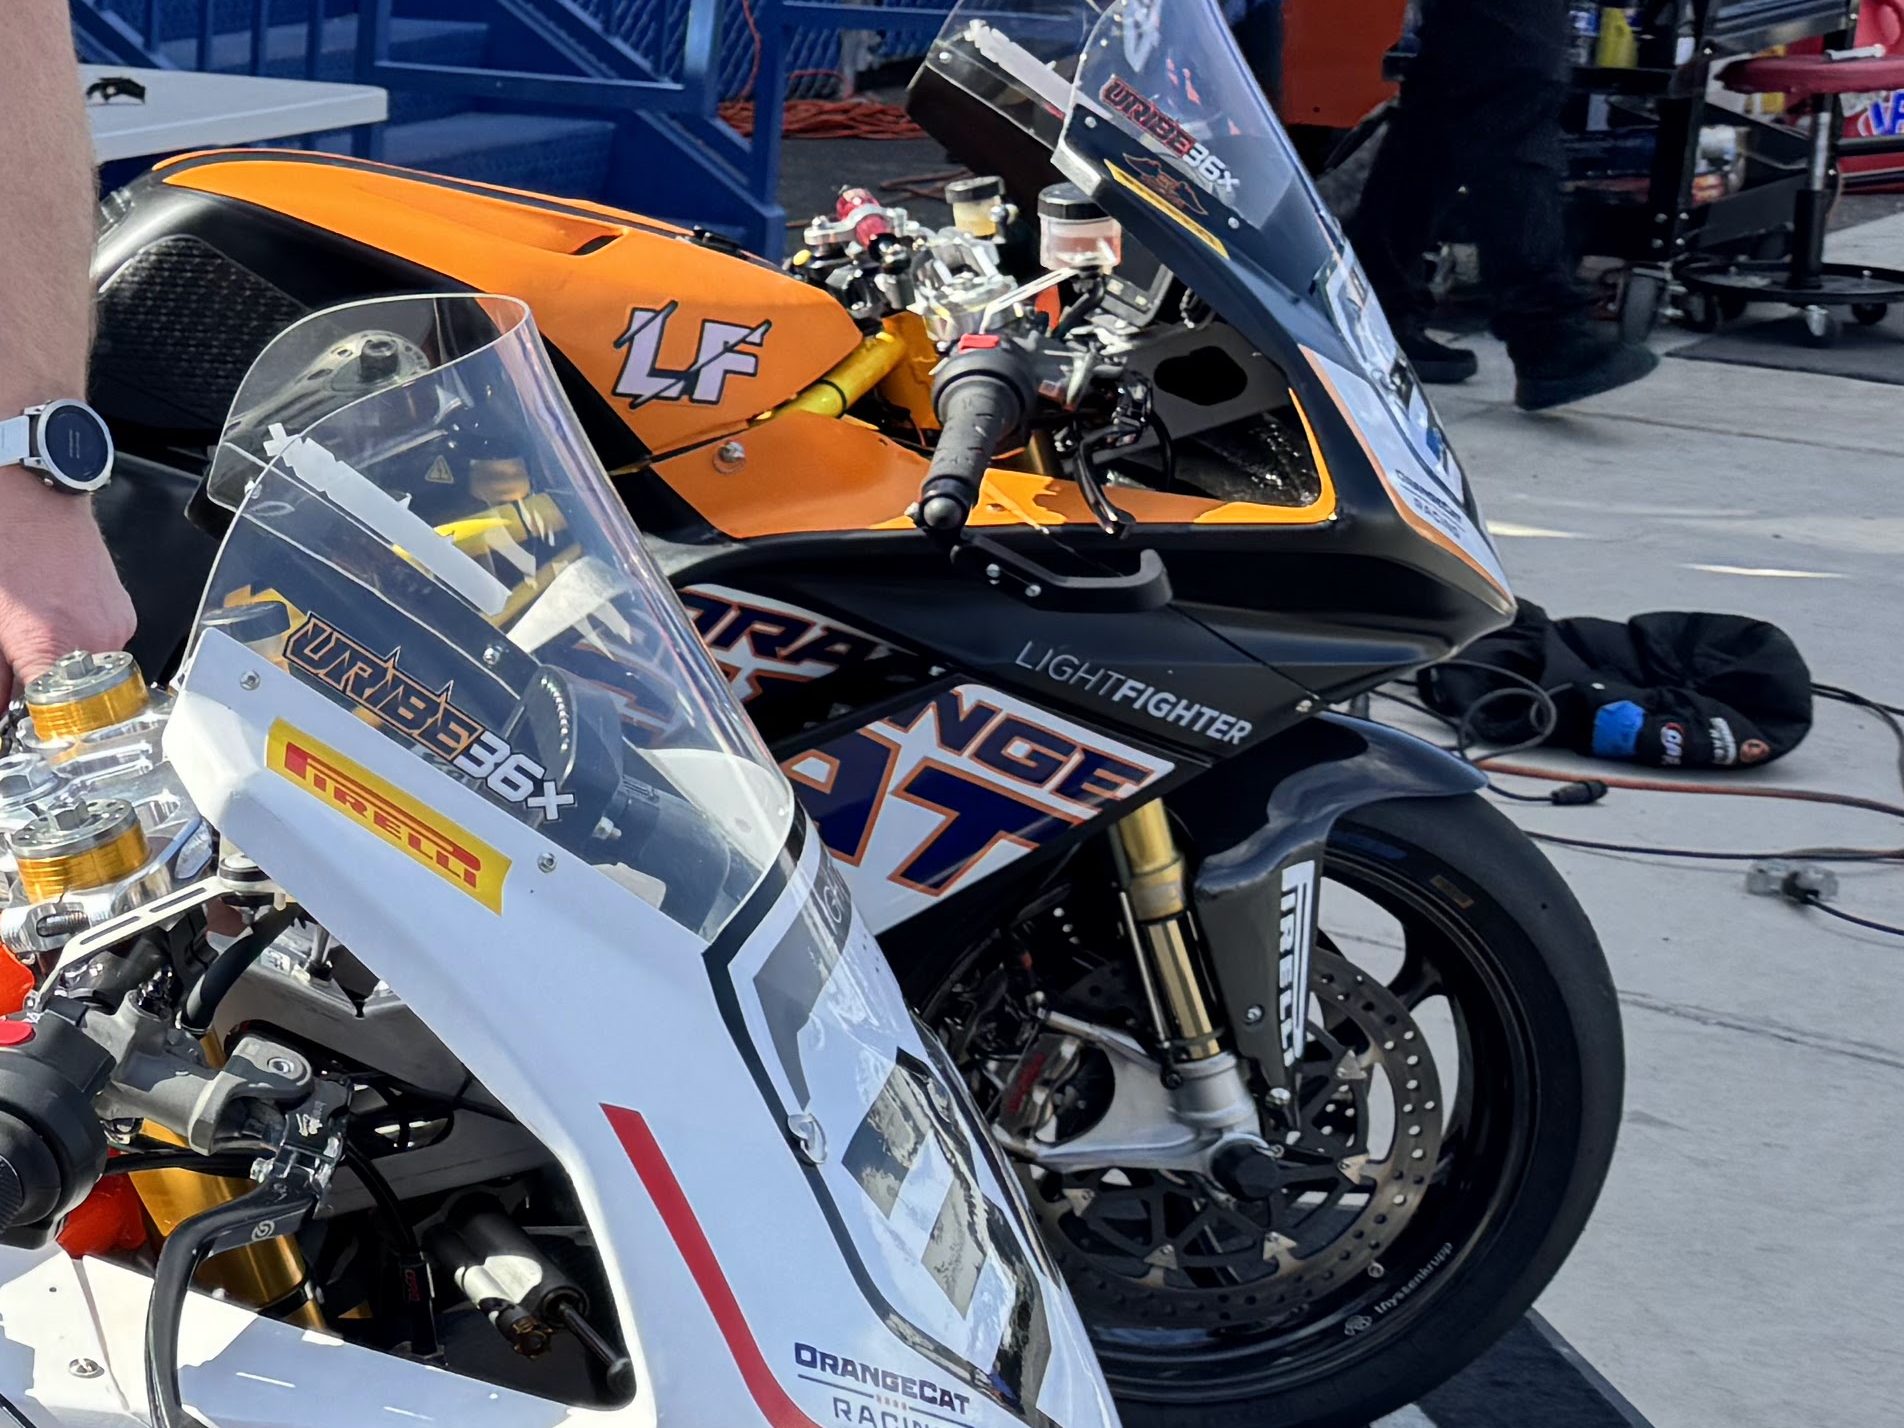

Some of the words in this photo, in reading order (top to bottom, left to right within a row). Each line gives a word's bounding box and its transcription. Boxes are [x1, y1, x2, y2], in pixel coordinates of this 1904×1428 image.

[614, 300, 772, 410] LF
[1013, 640, 1254, 746] LIGHTFIGHTER
[283, 740, 482, 890] PIRELLI
[1278, 859, 1317, 1068] PIRELLI
[1373, 1241, 1454, 1315] thyssenkrupp
[793, 1341, 970, 1416] ORANGECAT
